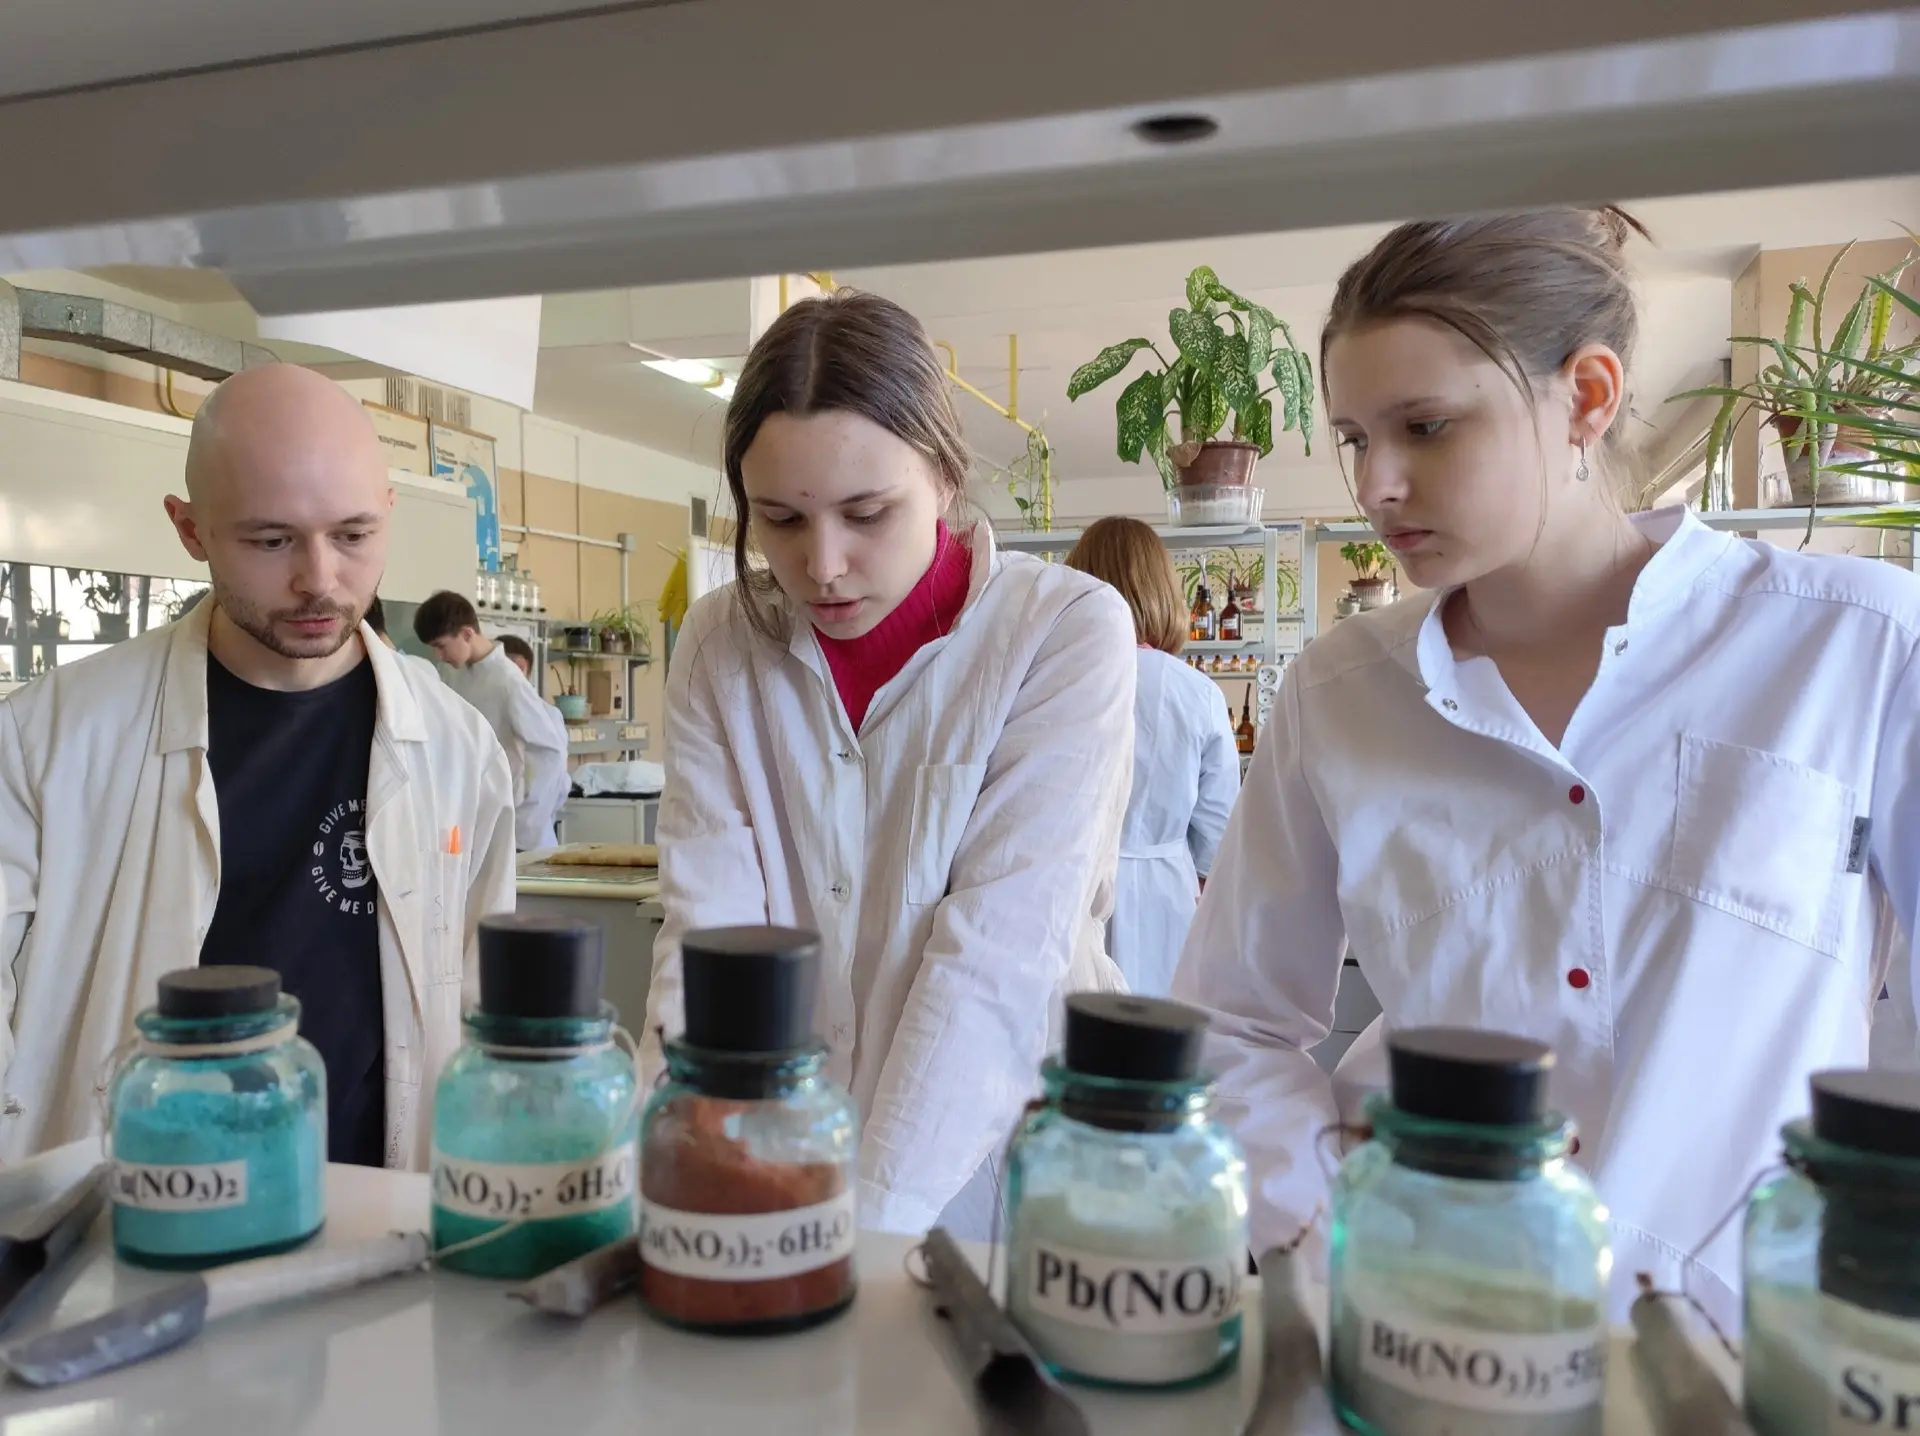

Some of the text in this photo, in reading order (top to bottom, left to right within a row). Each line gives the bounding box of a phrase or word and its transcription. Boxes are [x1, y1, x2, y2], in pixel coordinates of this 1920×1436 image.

[319, 803, 346, 834] GIVE
[311, 865, 338, 903] GIVE
[339, 898, 361, 915] ME
